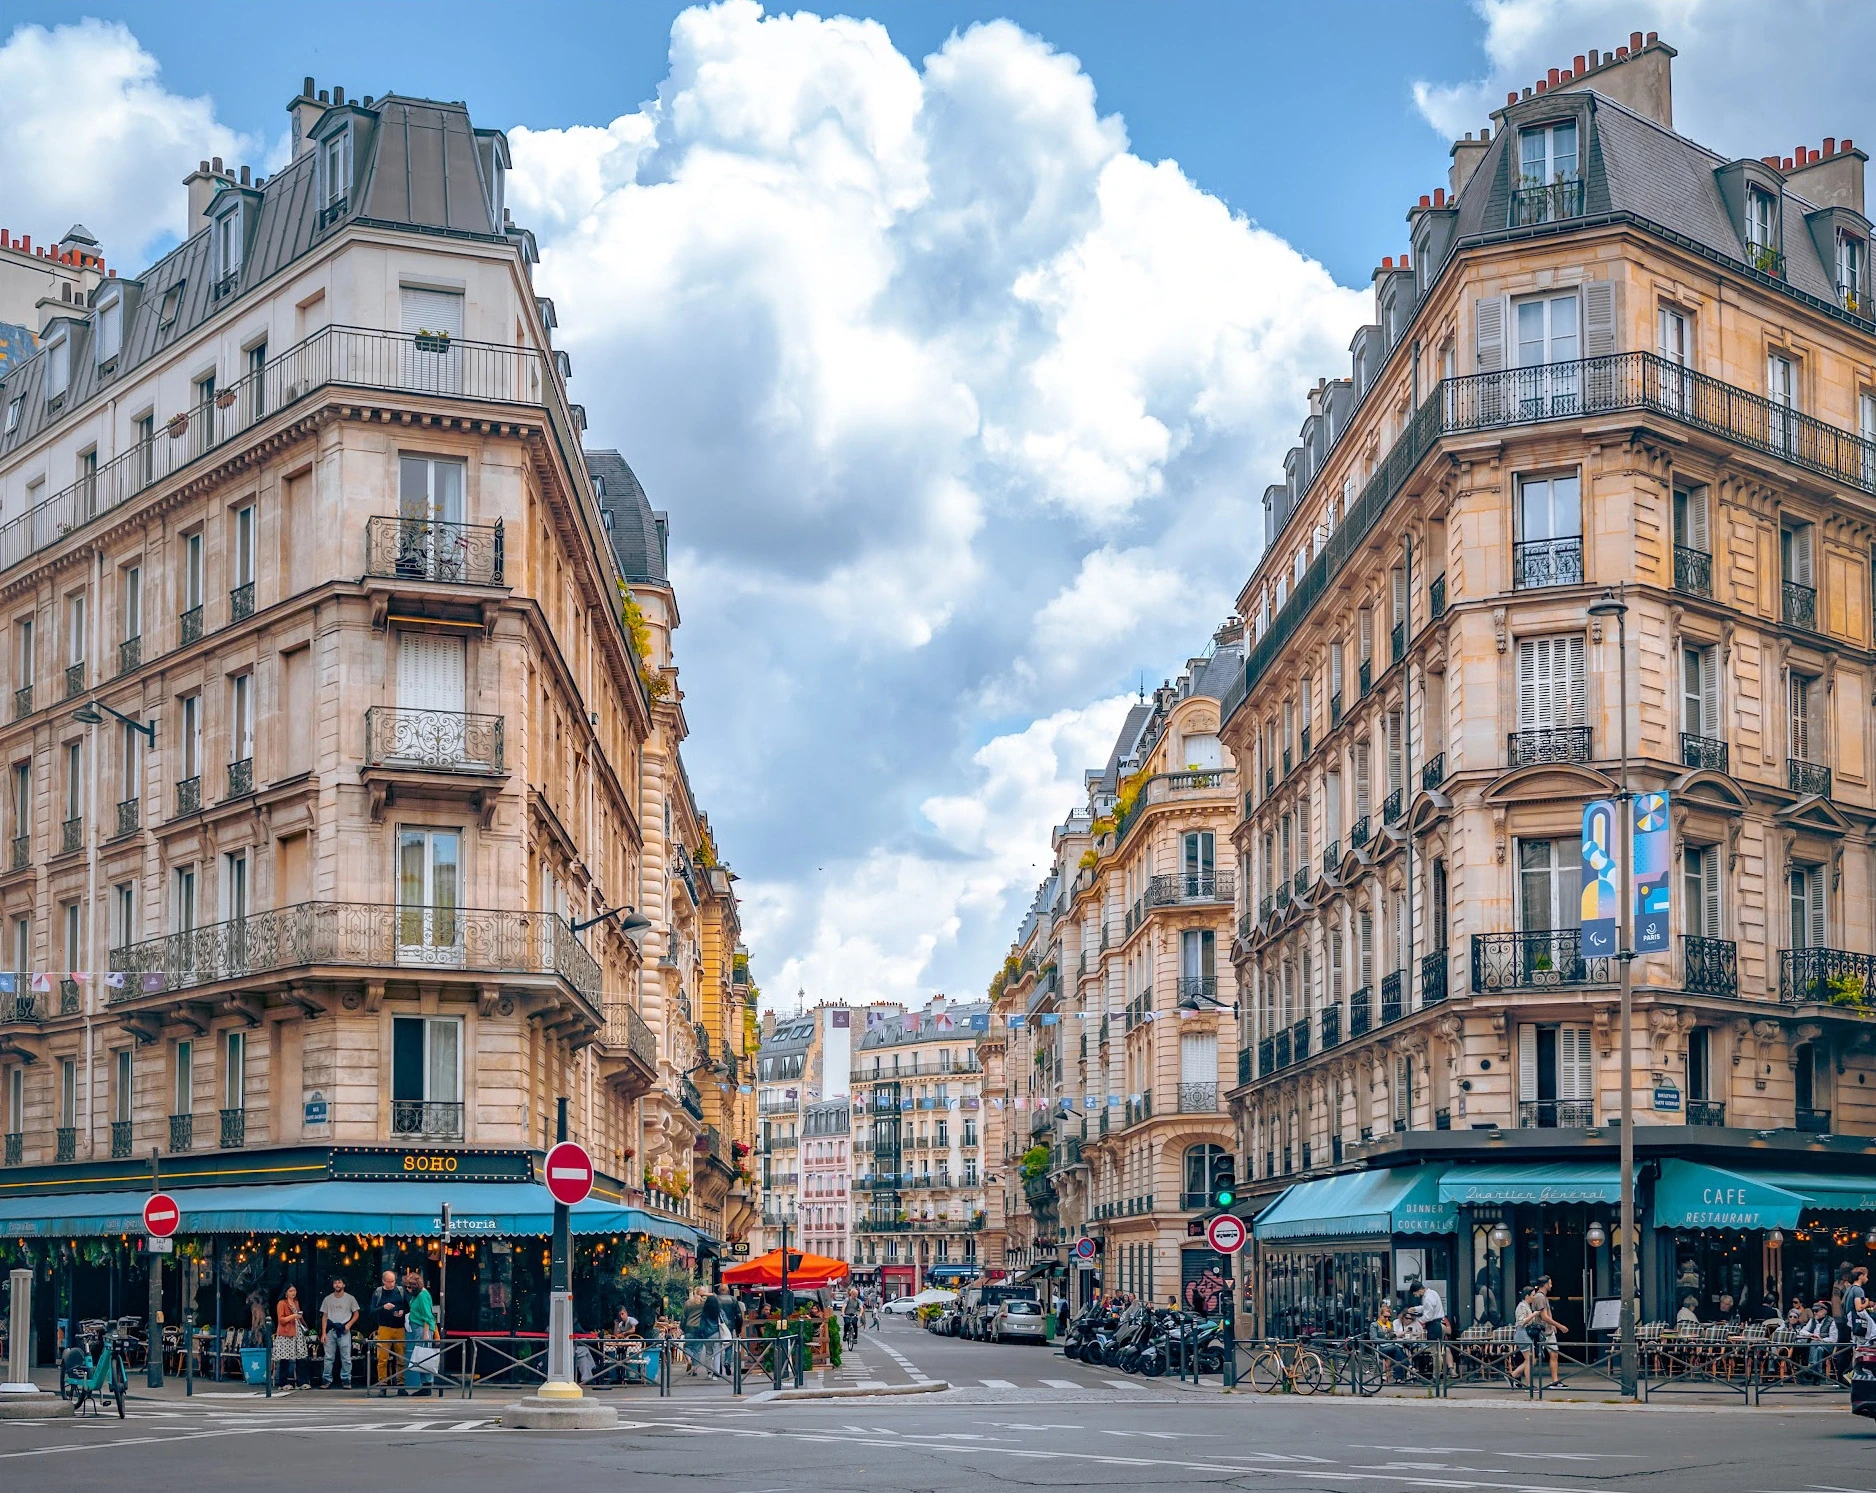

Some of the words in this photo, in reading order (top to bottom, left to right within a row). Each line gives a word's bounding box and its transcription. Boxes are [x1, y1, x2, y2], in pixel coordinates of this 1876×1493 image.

[404, 1155, 457, 1171] SOHO
[1466, 1186, 1536, 1198] Quartier
[1538, 1186, 1606, 1200] Général
[1703, 1188, 1746, 1204] CAFE
[1406, 1204, 1444, 1213] DINNER
[1686, 1212, 1760, 1223] RESTAURANT
[433, 1218, 497, 1229] Tattoria
[1398, 1220, 1454, 1230] COCKTAILS
